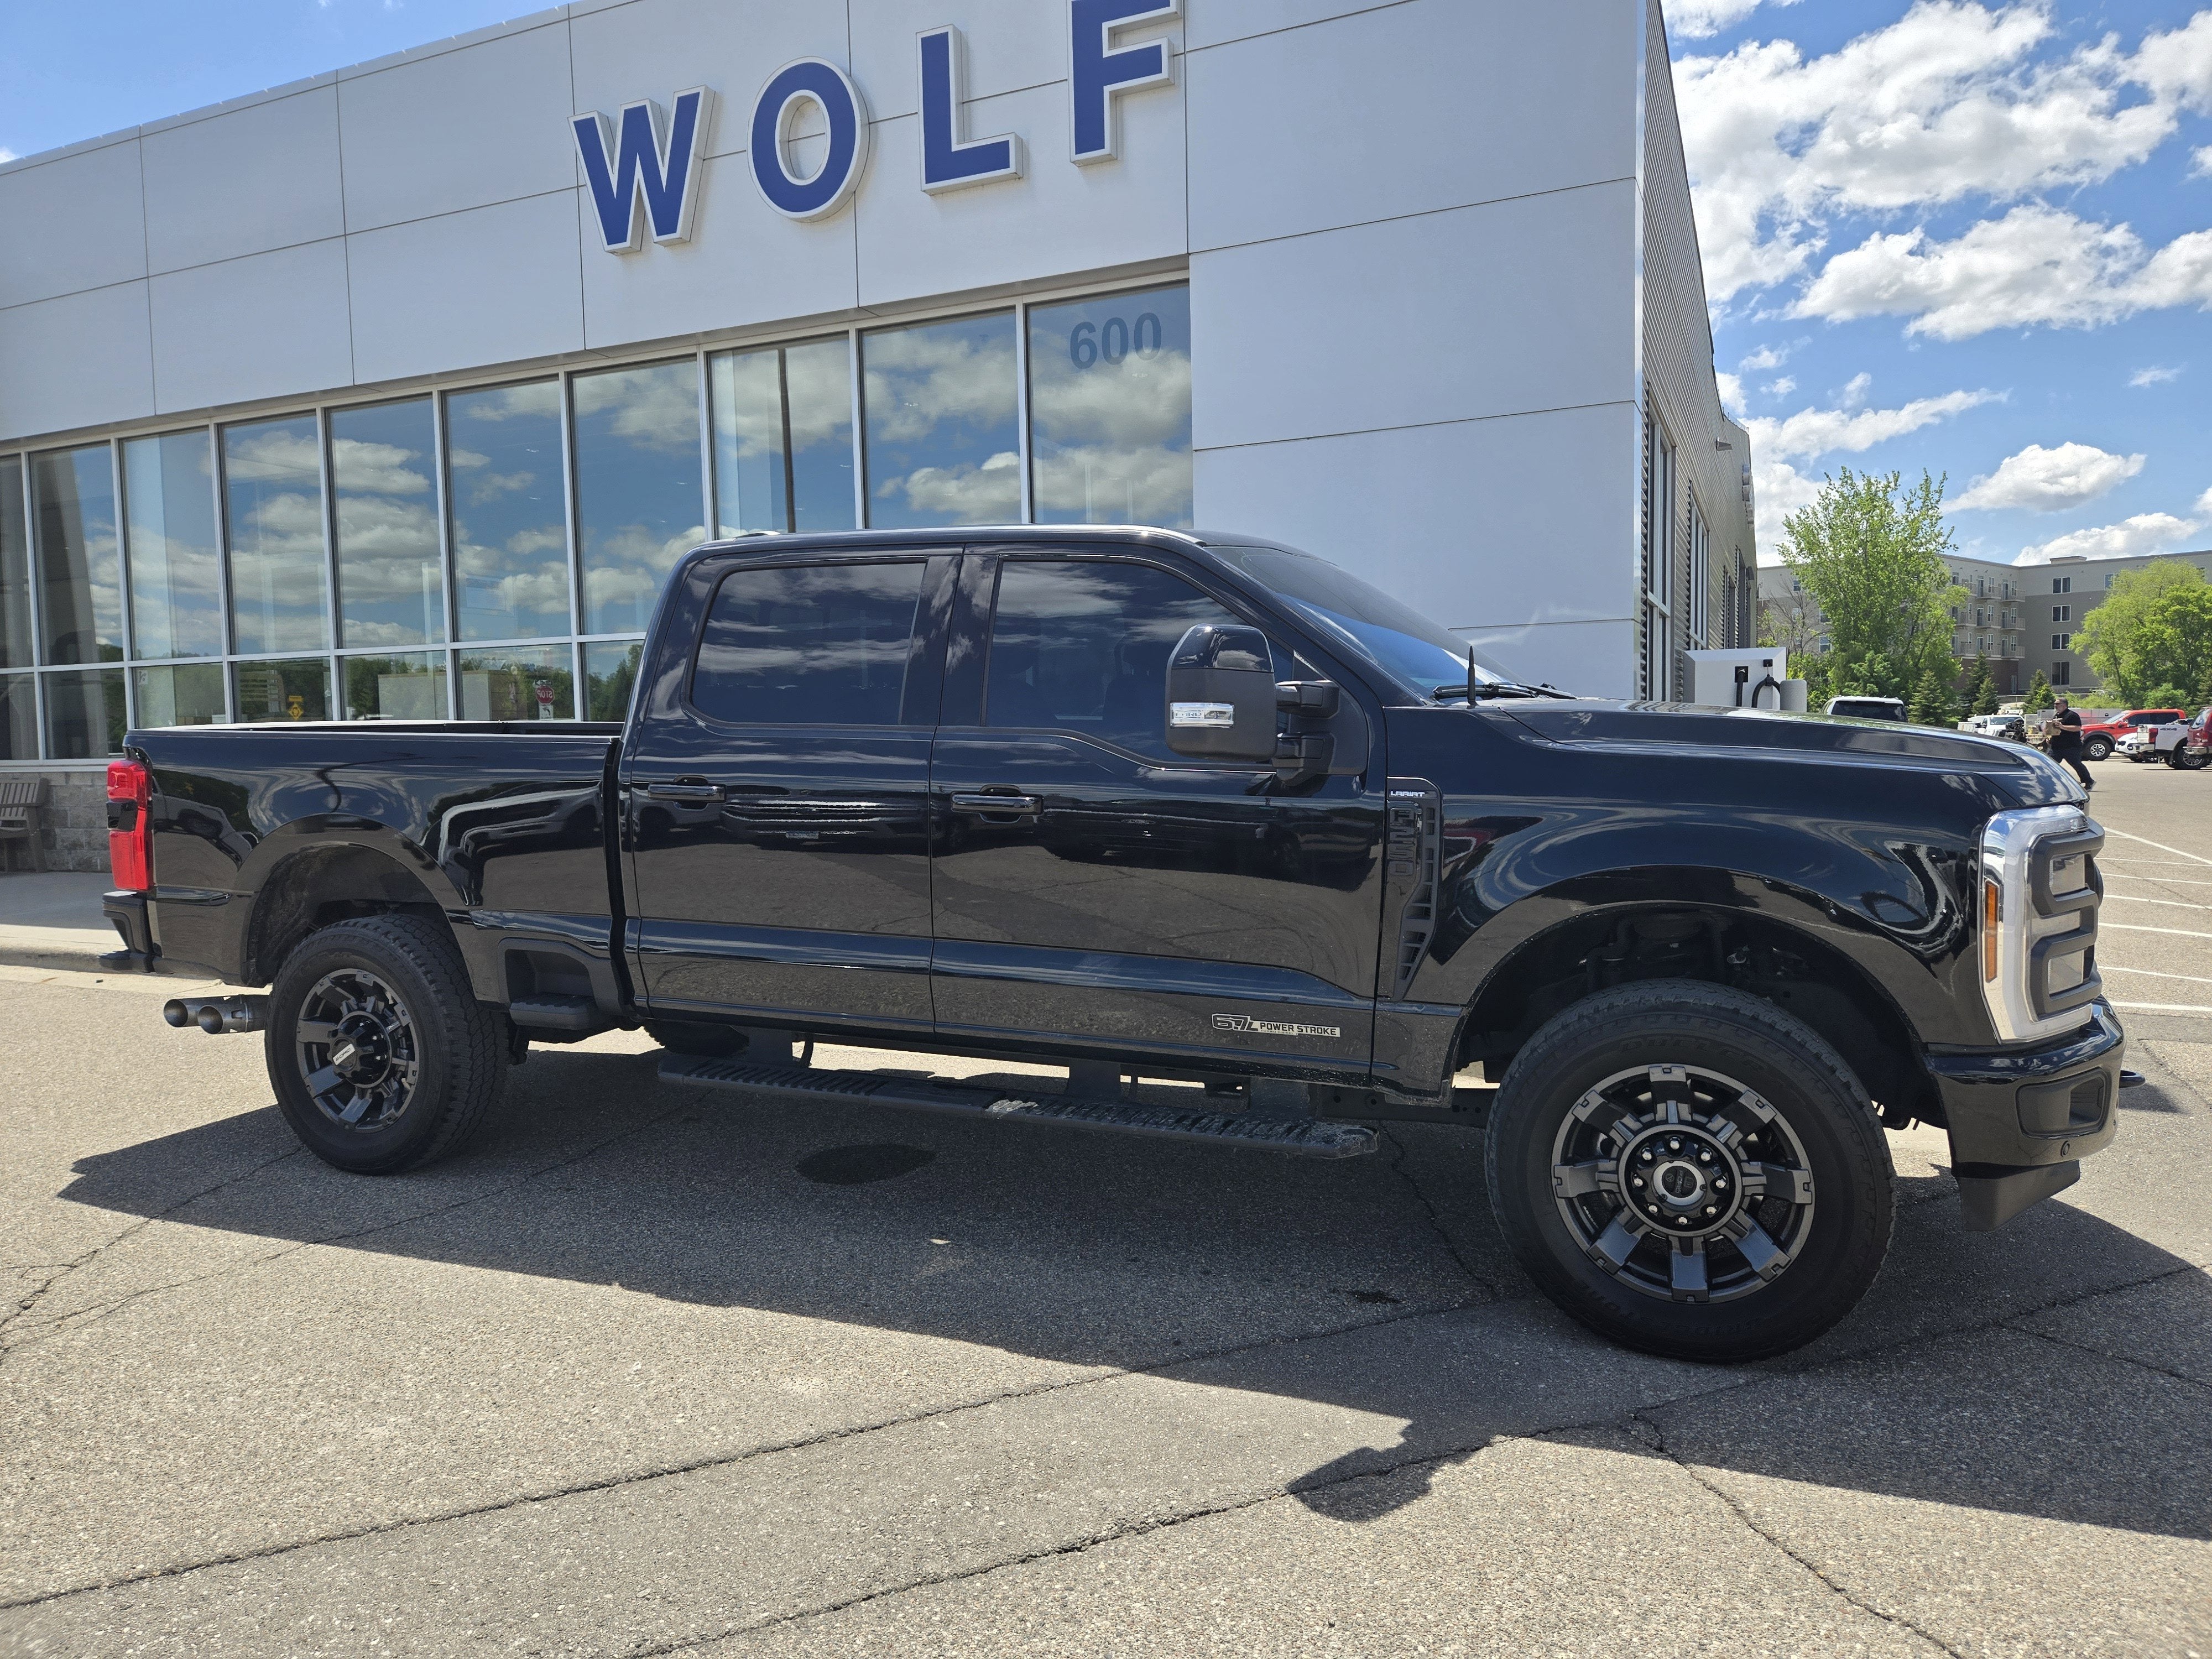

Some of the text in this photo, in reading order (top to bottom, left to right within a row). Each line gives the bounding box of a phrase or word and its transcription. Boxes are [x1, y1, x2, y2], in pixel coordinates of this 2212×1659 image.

[568, 0, 1182, 254] WOLF
[1070, 312, 1161, 369] 600
[1260, 1022, 1294, 1032] POWER
[1297, 1025, 1337, 1036] STROKE
[336, 1048, 351, 1062] FORD
